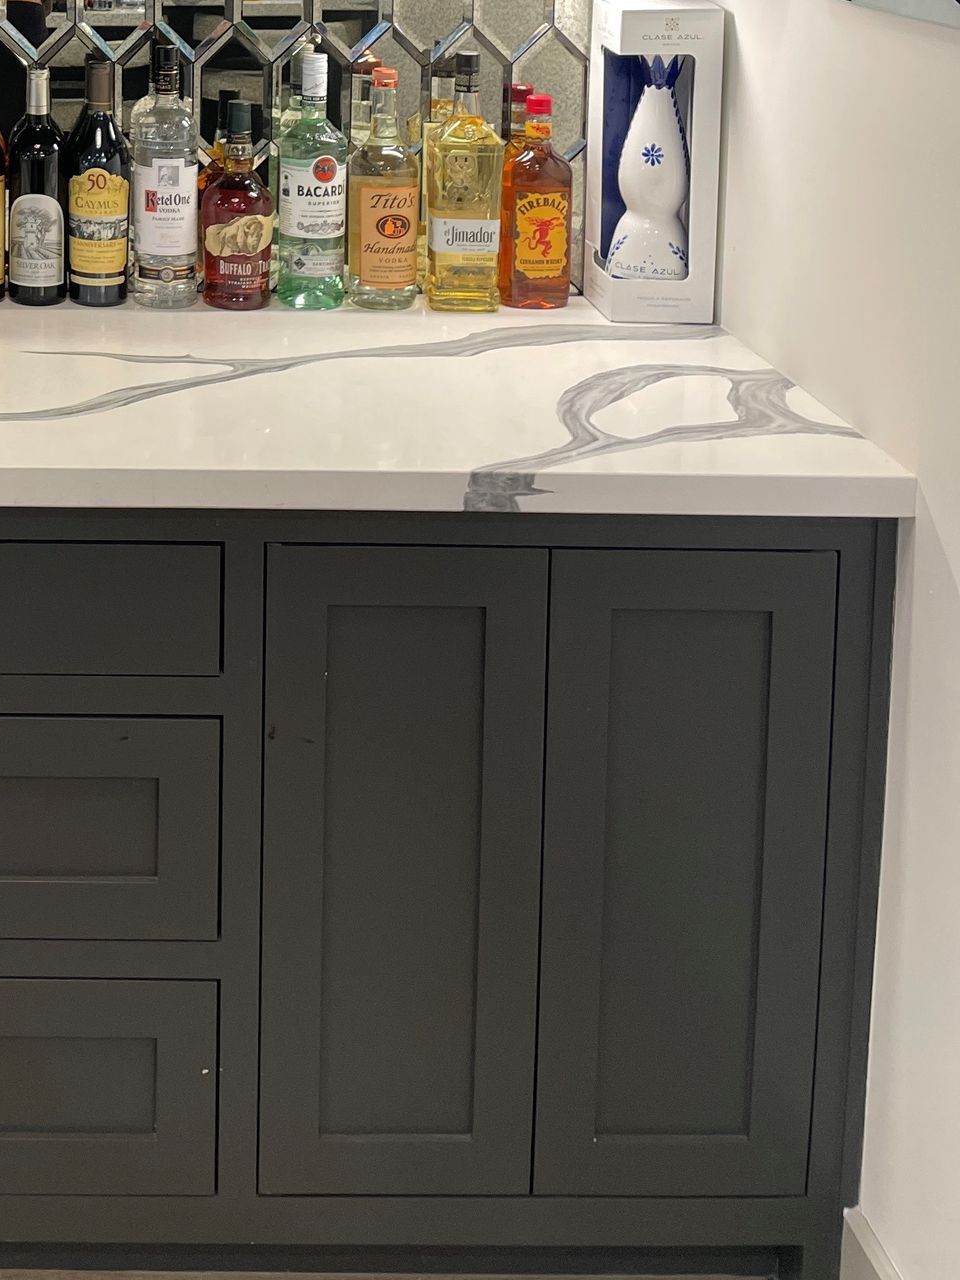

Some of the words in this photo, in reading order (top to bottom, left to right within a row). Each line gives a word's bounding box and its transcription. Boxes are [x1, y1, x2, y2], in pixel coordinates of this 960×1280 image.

[87, 173, 107, 192] 50
[75, 196, 119, 210] CAYMUS
[145, 190, 172, 208] Ketel
[174, 193, 190, 206] One
[370, 192, 415, 209] Tito's
[518, 197, 567, 216] FIREBALL
[446, 225, 495, 246] Jimador
[16, 259, 39, 270] SILVER
[40, 262, 56, 270] OAK
[219, 259, 252, 276] BUFFALO
[614, 261, 646, 273] CLASE
[652, 268, 680, 276] AZUL
